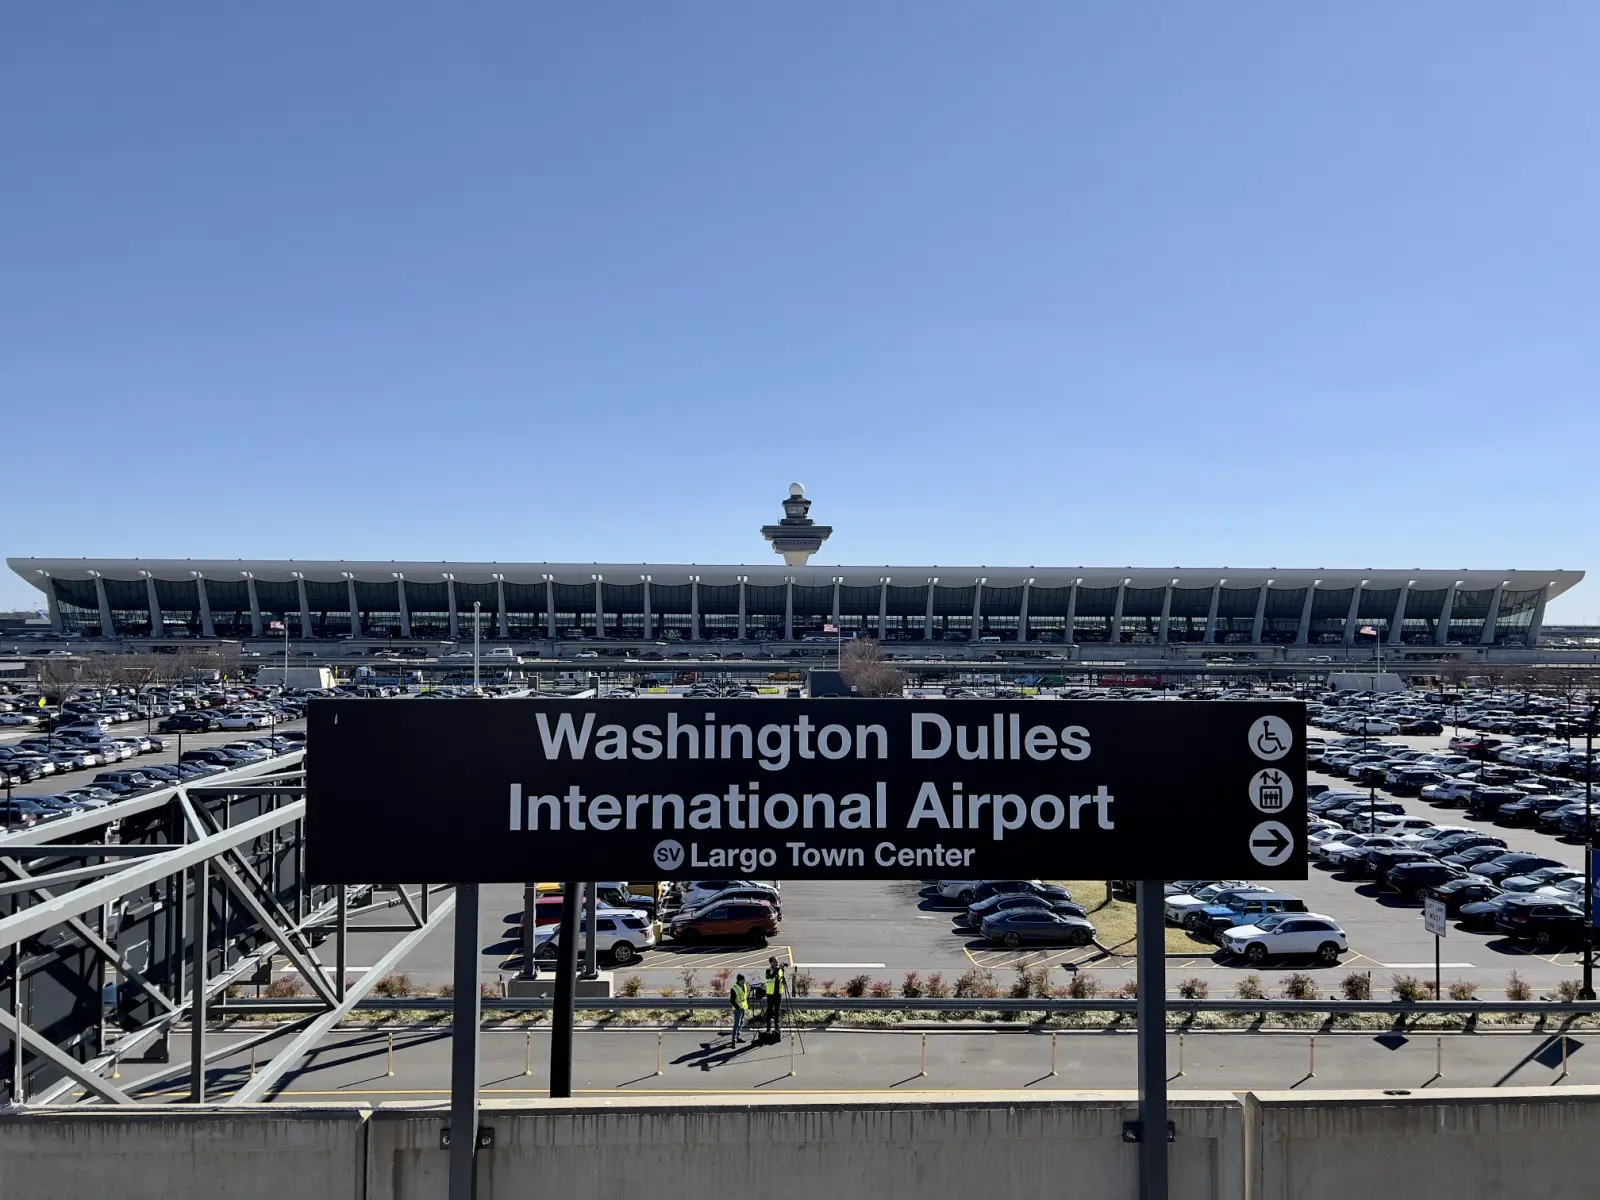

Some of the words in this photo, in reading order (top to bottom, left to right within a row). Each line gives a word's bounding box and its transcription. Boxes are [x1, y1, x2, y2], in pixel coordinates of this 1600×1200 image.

[1116, 674, 1136, 682] AVIS
[535, 712, 888, 771] Washington
[911, 713, 1092, 761] Dulles
[509, 781, 887, 831] International
[906, 781, 1115, 841] Airport
[656, 847, 681, 862] SV
[691, 842, 777, 873] Largo
[786, 842, 865, 867] Town
[874, 841, 976, 867] Center
